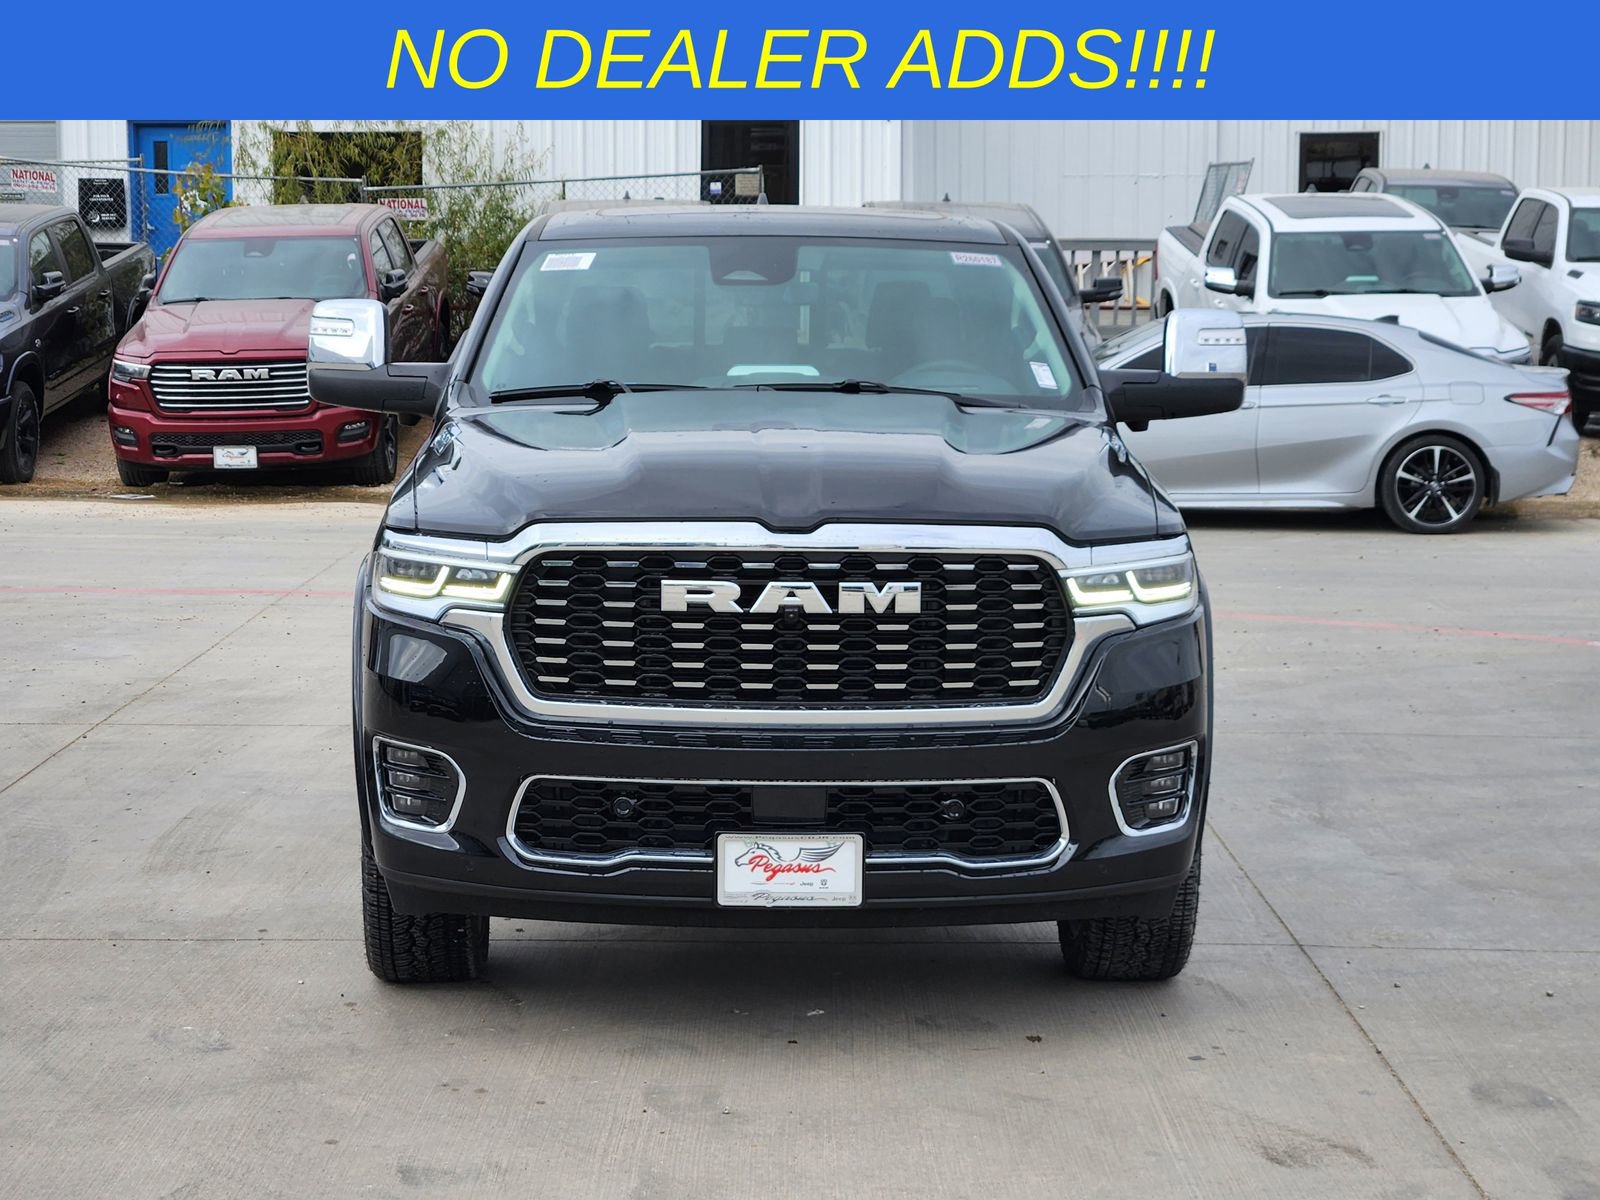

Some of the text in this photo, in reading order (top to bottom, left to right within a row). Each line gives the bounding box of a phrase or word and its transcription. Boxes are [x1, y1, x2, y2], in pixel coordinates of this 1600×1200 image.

[12, 168, 56, 182] NATIONAL
[190, 368, 270, 380] RAM
[661, 579, 922, 614] RAM
[749, 854, 837, 881] Pegasus
